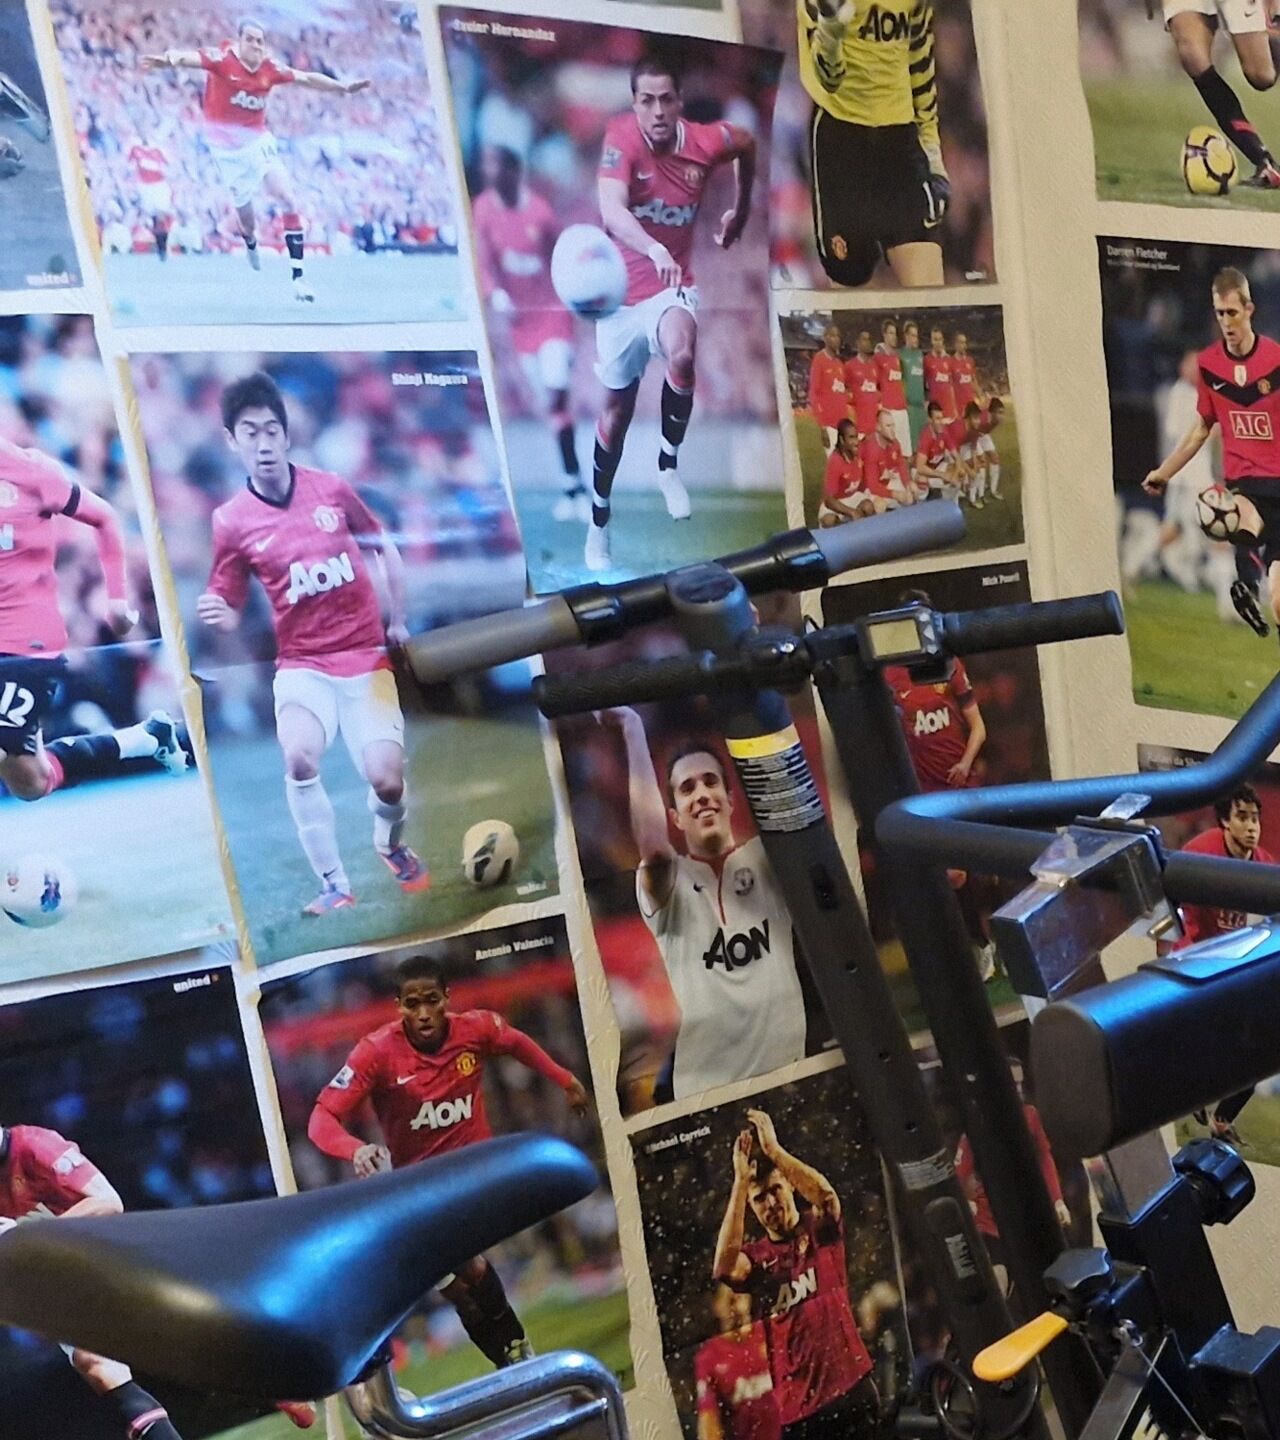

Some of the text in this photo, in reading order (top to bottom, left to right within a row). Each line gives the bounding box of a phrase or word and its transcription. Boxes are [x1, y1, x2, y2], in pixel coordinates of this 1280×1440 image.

[858, 4, 908, 42] AON
[1106, 245, 1168, 260] Darren Fletcher
[1235, 417, 1270, 437] AIG
[286, 552, 355, 605] AON
[914, 707, 950, 736] AON
[475, 935, 554, 961] Antonio Valencia
[703, 918, 771, 972] AON
[173, 974, 212, 993] united
[410, 1094, 472, 1131] AON
